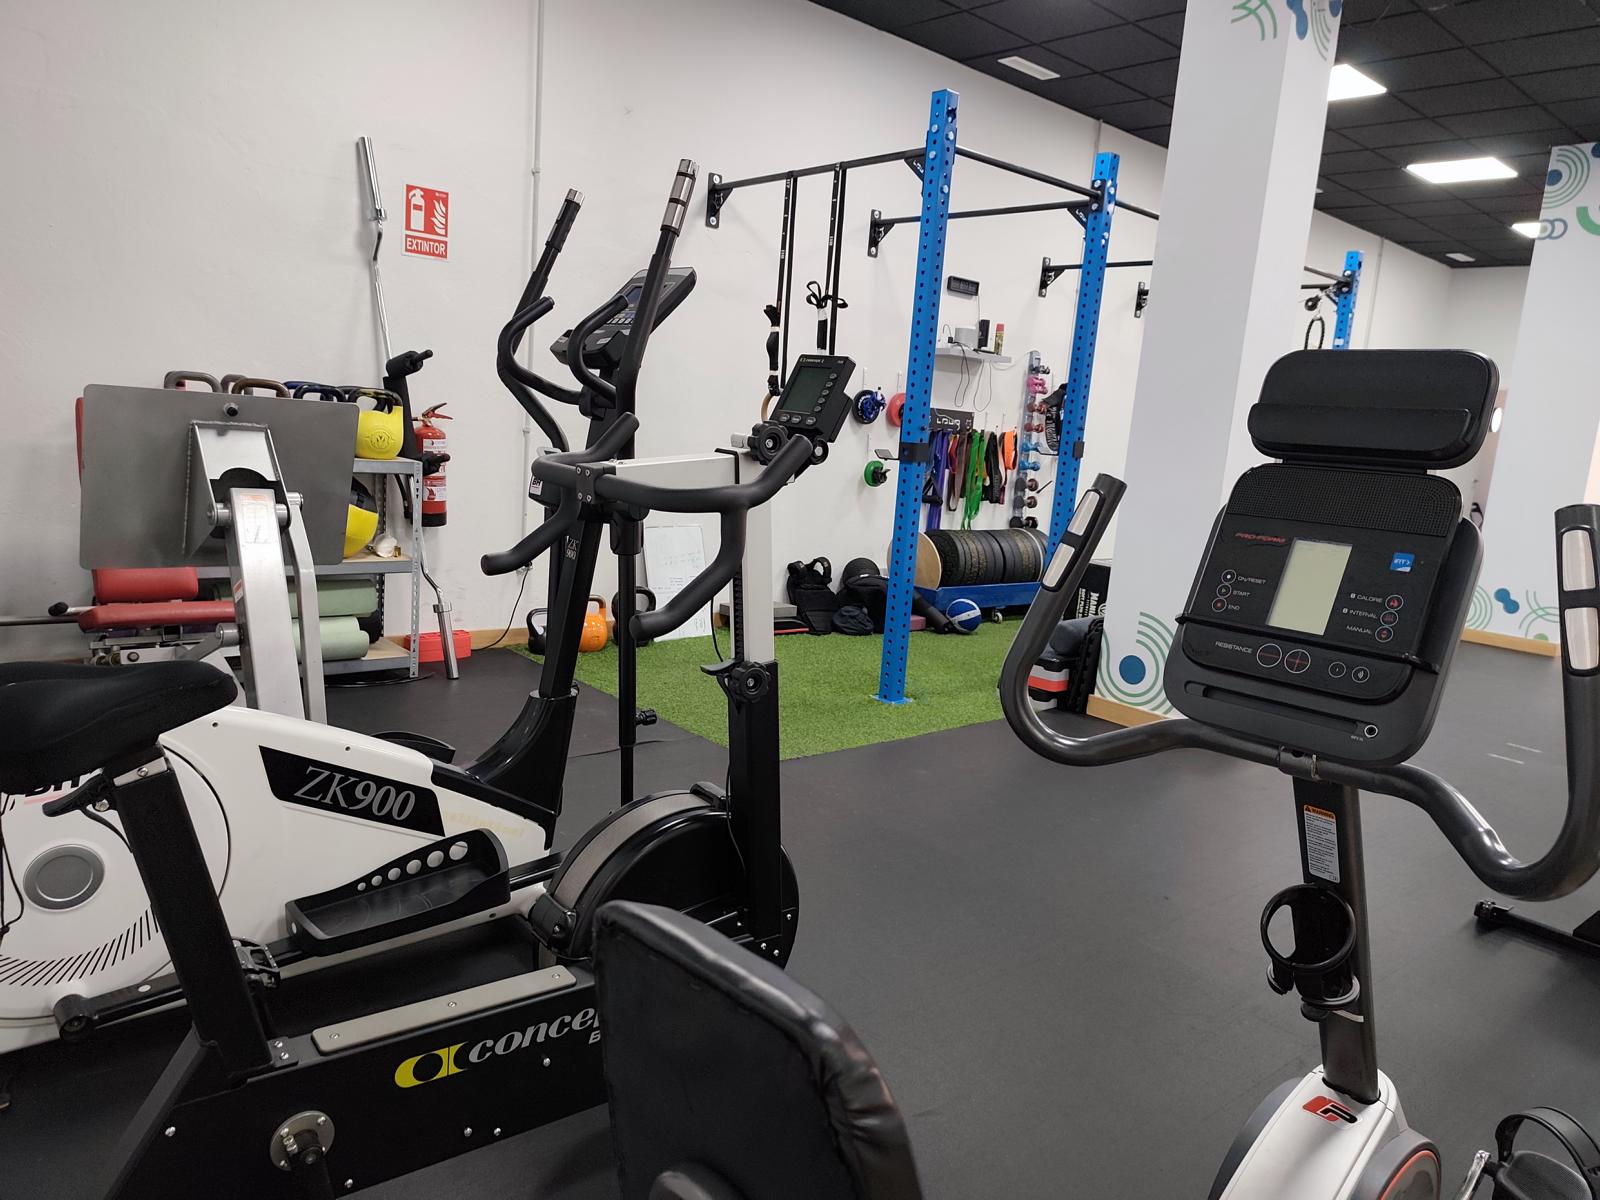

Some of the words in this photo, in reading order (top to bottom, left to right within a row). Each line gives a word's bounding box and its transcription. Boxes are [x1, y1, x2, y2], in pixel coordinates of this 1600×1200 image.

[406, 237, 446, 256] EXTINTOR
[1088, 592, 1100, 617] MANI
[294, 765, 416, 821] ZK900
[468, 1008, 600, 1063] conce
